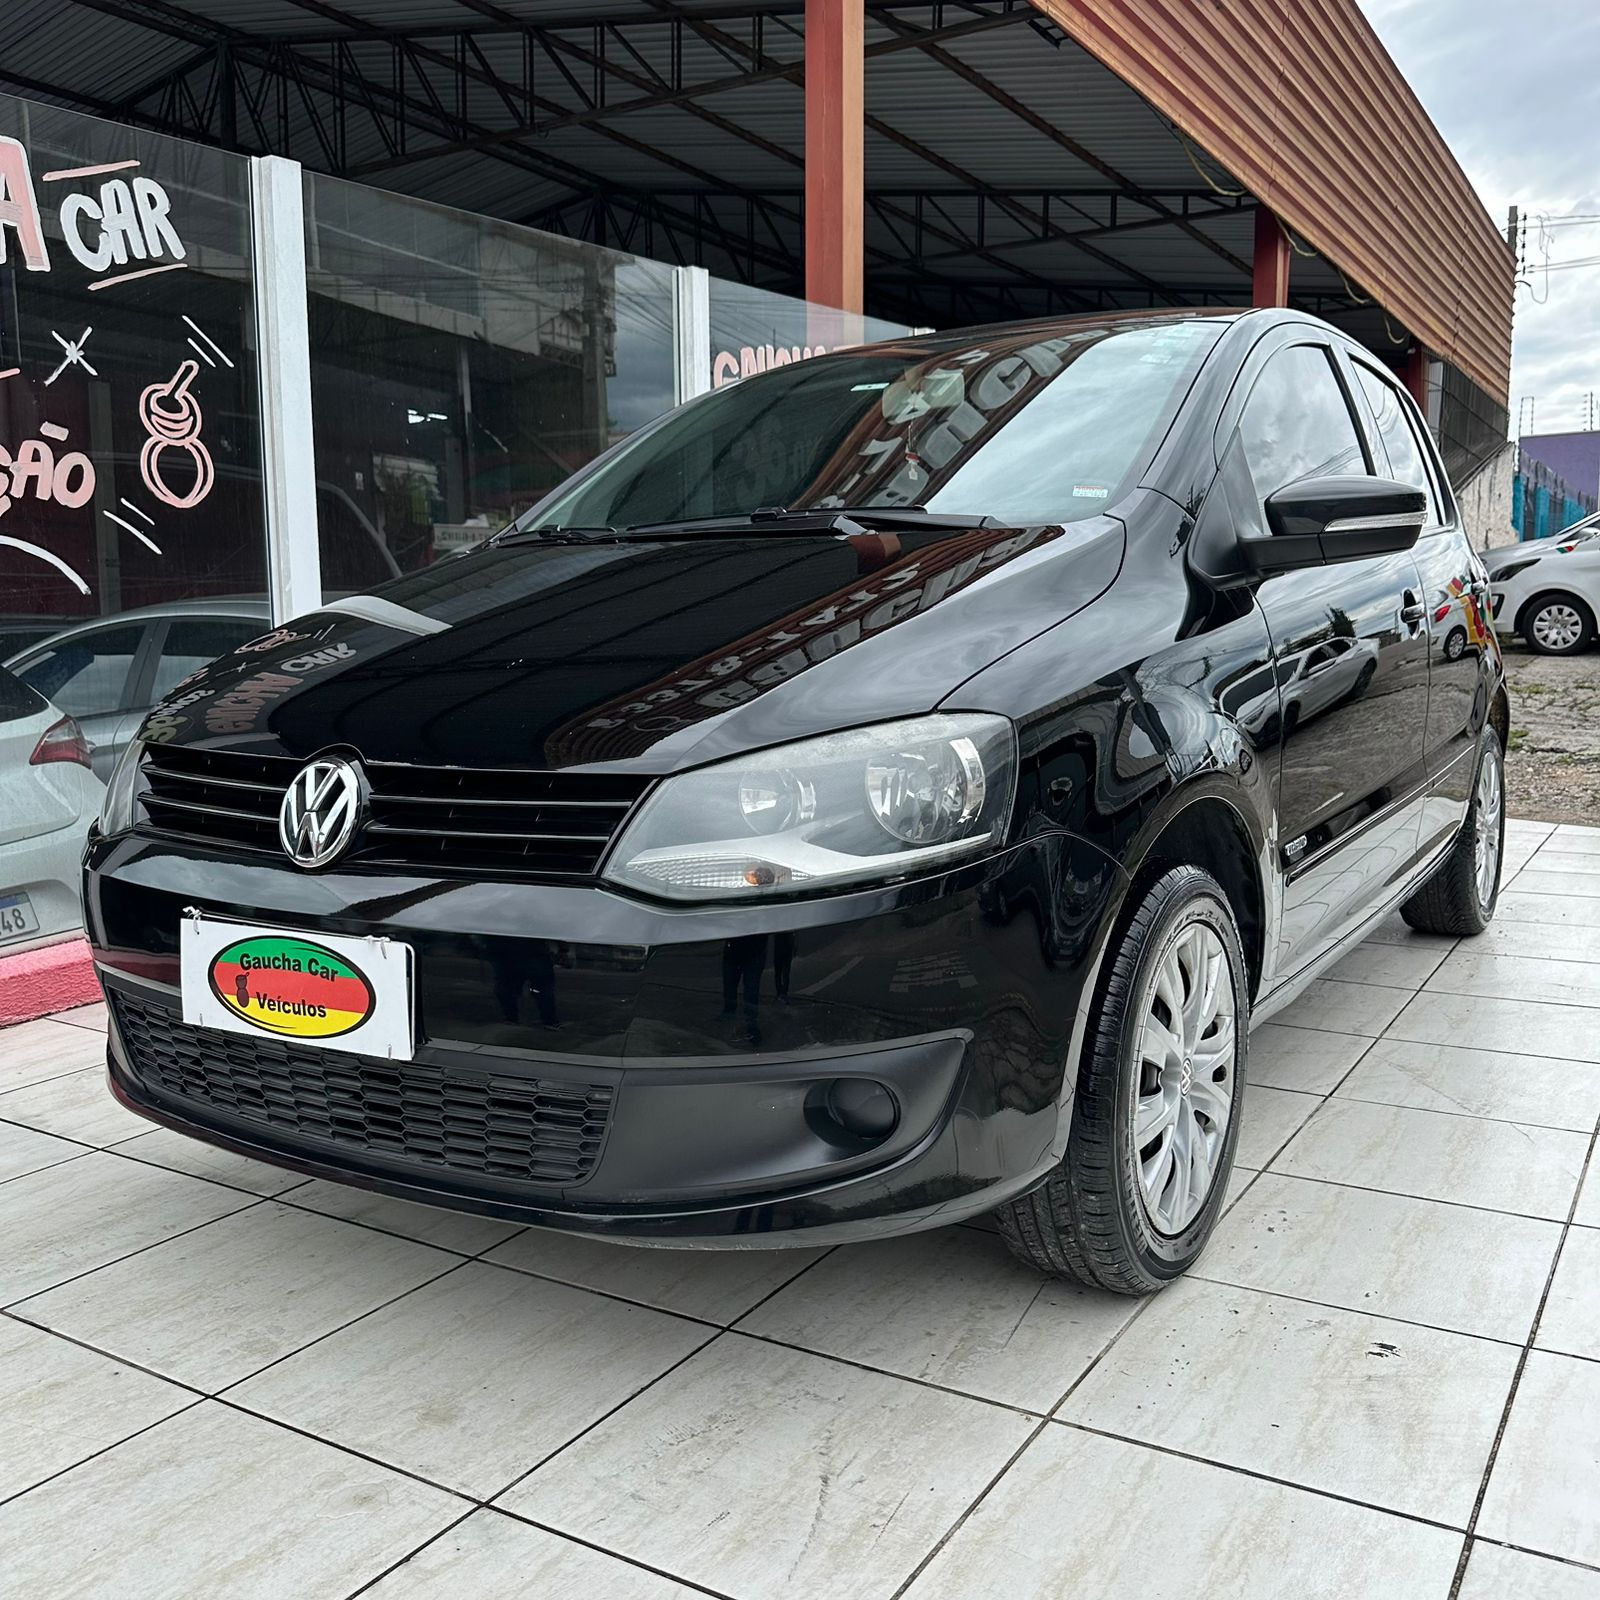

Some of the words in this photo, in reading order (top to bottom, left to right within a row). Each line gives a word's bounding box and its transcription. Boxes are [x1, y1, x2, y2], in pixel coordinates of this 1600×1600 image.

[59, 176, 187, 272] CAR
[240, 952, 302, 972] Gaucha
[307, 957, 339, 982] Car
[256, 991, 327, 1018] Veículos
